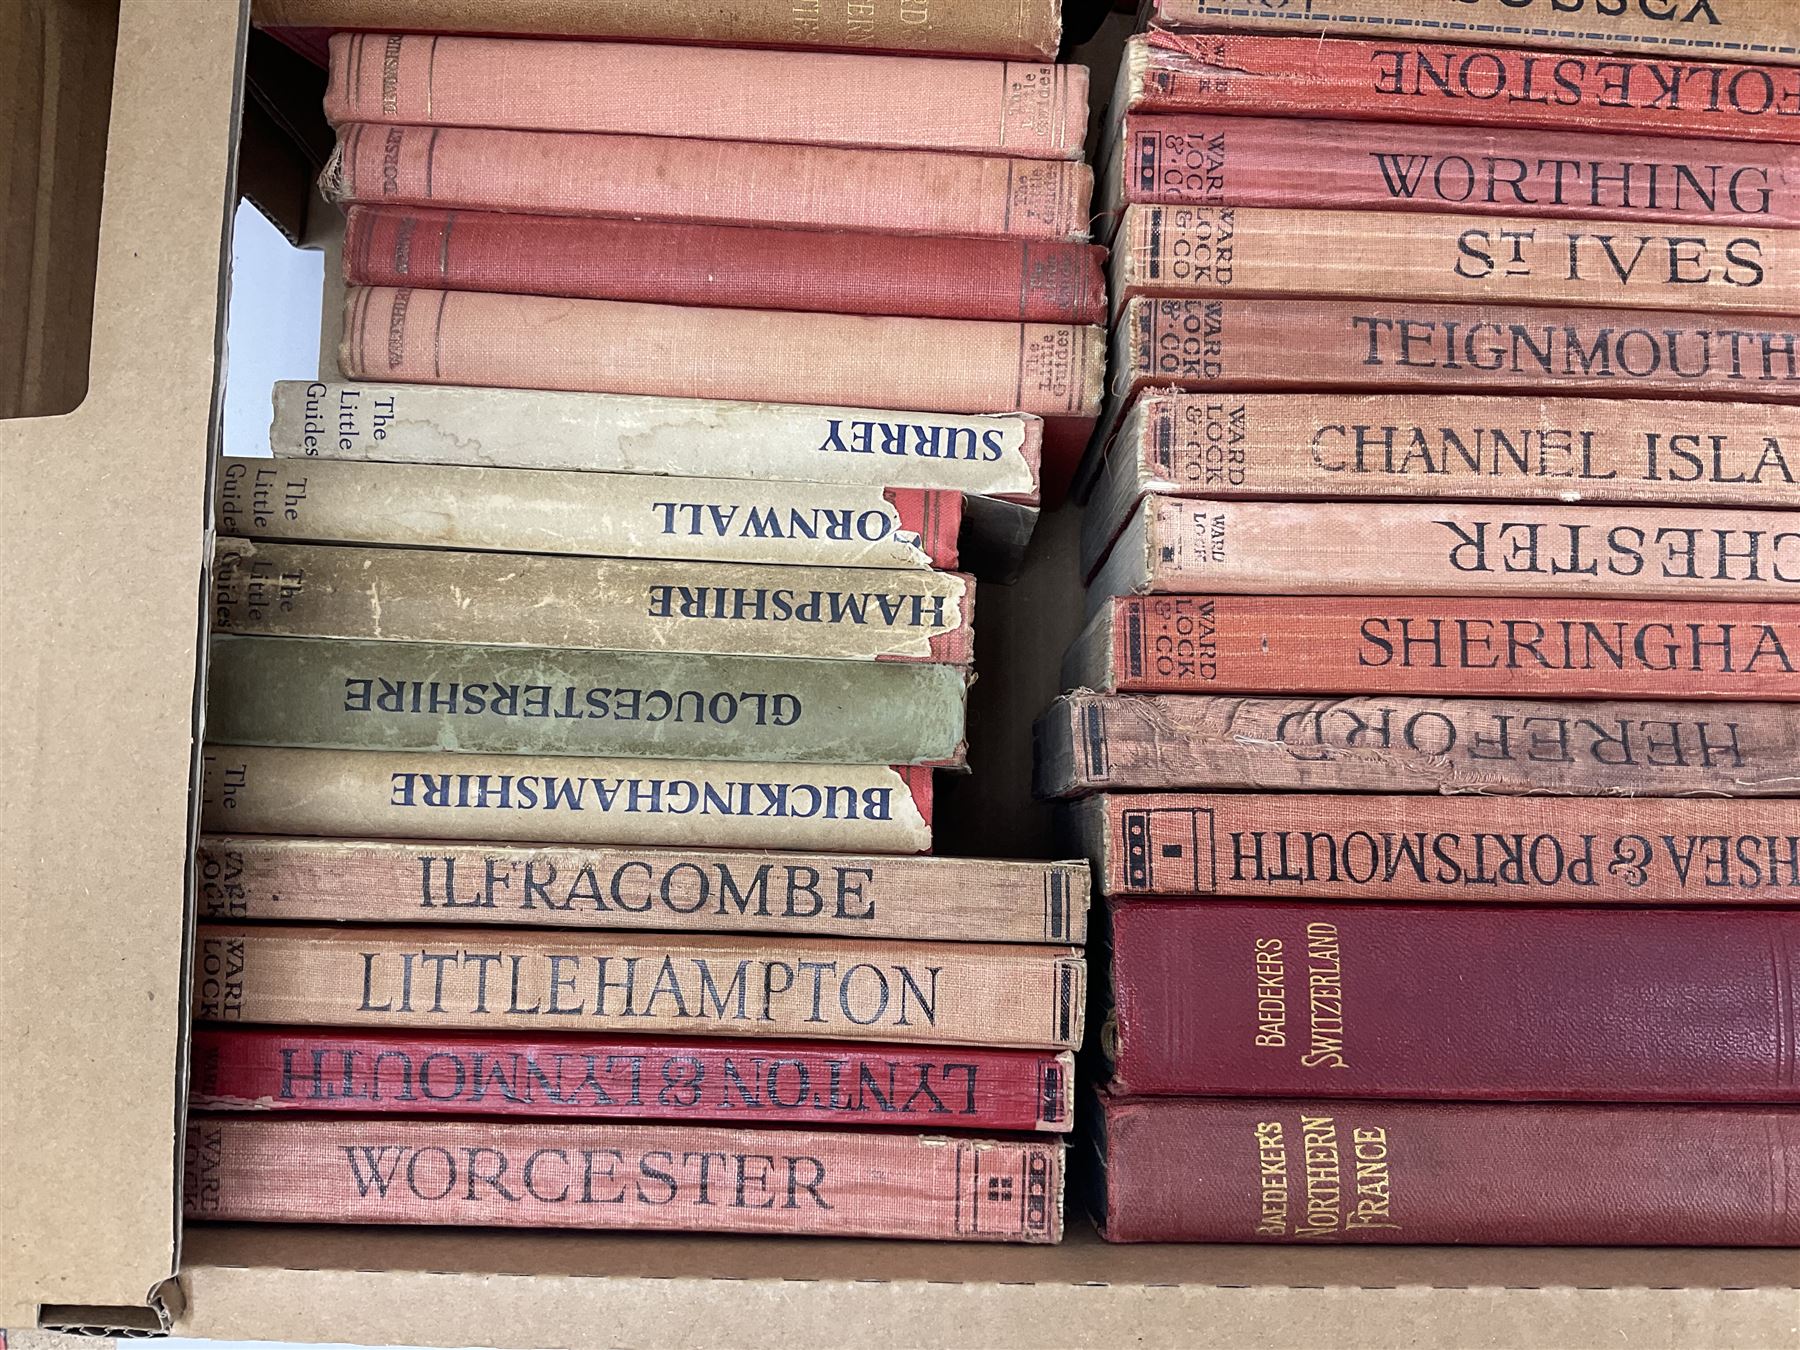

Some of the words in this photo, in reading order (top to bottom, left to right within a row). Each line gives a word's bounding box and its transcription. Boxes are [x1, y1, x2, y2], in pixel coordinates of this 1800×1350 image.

[383, 127, 403, 194] DORSET
[1186, 133, 1204, 202] LOC
[1206, 132, 1225, 203] WAR
[1369, 153, 1775, 214] WORTHING
[1195, 207, 1213, 284] LOCK
[1215, 207, 1235, 287] WARD
[1565, 233, 1765, 288] IVES
[1039, 334, 1054, 391] Little
[1054, 329, 1069, 397] Guides
[1183, 300, 1202, 379] LOCK
[1204, 300, 1223, 380] WARD
[1352, 315, 1800, 380] TEIGNMOUTH
[305, 383, 327, 456] Guides
[339, 390, 360, 450] Little
[374, 396, 396, 440] The
[818, 418, 1005, 462] SURREY
[1206, 404, 1223, 485] LOCK
[1228, 404, 1246, 486] WARD
[1311, 423, 1618, 481] CHANNEL
[1644, 432, 1798, 485] ISLA
[222, 463, 247, 534] Guides
[253, 468, 277, 529] Little
[284, 478, 308, 521] The
[1211, 513, 1226, 563] WARD
[1431, 520, 1800, 583] CHESTER
[216, 551, 242, 629] Guides
[248, 560, 273, 621] Little
[280, 569, 304, 613] The
[648, 584, 947, 628] HAMPSHIRE
[1176, 599, 1196, 679] LOCK
[1199, 599, 1218, 681] WARD
[343, 677, 802, 727] GLOUCESTERSHIRE
[1276, 707, 1747, 769] HEREFORD
[222, 764, 248, 810] The
[390, 771, 895, 822] BUCKINGHAMSHIRE
[417, 855, 877, 921] ILFRACOMBE
[1228, 829, 1598, 886] PORTSMOUTH
[1607, 833, 1654, 887] &
[358, 949, 943, 1028] LITTLEHAMPTON
[1254, 938, 1287, 1048] BAEDEKER'S
[1301, 922, 1350, 1069] SWITZERLAND
[277, 1046, 645, 1108] LYNMOUTH
[660, 1057, 706, 1108] &
[722, 1055, 981, 1115] LYNTON
[337, 1144, 836, 1212] WORCESTER
[1255, 1122, 1288, 1237] BAEDEKER'S
[1295, 1115, 1341, 1241] NORTHERN
[1346, 1126, 1403, 1231] FRANCE
